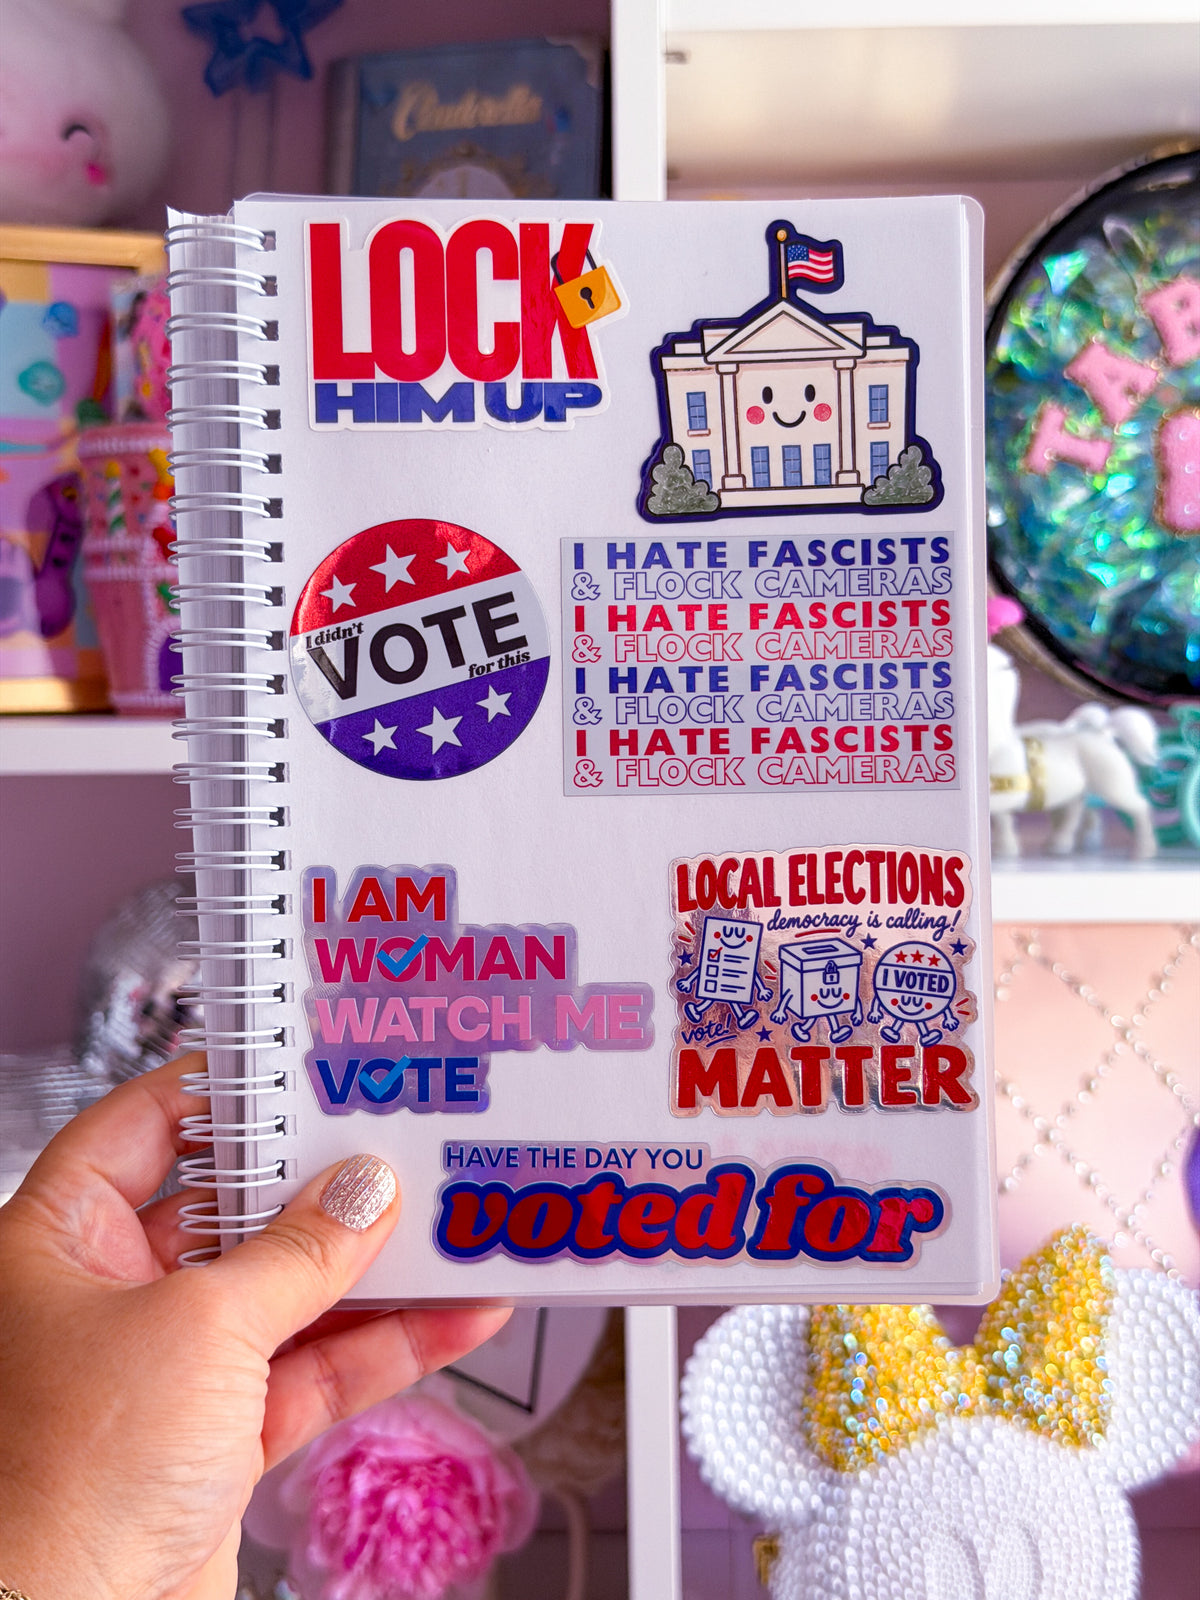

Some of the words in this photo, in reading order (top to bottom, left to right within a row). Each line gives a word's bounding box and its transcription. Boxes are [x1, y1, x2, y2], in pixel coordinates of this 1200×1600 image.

[310, 219, 599, 382] LOCK
[314, 382, 476, 424] HIM
[484, 382, 603, 423] UP
[574, 543, 584, 569] I
[607, 541, 727, 570] HATE
[748, 537, 949, 568] FASCISTS
[571, 572, 600, 600] &
[614, 570, 742, 600] FLOCK
[754, 566, 953, 598] CAMERAS
[575, 605, 585, 632] I
[608, 604, 728, 632] HATE
[749, 599, 950, 630] FASCISTS
[306, 635, 312, 649] I
[306, 591, 528, 700] VOTE
[572, 634, 601, 663] &
[615, 632, 743, 663] FLOCK
[755, 628, 953, 660] CAMERAS
[468, 663, 495, 678] for
[498, 651, 530, 669] this
[575, 667, 585, 694] I
[609, 665, 729, 694] HATE
[750, 661, 952, 692] FASCISTS
[572, 697, 602, 725] &
[616, 694, 744, 725] FLOCK
[756, 691, 954, 723] CAMERAS
[576, 729, 587, 757] I
[609, 727, 730, 756] HATE
[751, 724, 953, 755] FASCISTS
[573, 759, 604, 788] &
[617, 757, 745, 787] FLOCK
[757, 753, 956, 785] CAMERAS
[676, 857, 781, 913] LOCAL
[788, 850, 965, 908] ELECTIONS
[312, 878, 326, 923] I
[347, 876, 447, 923] AM
[767, 909, 862, 937] democracy
[867, 911, 882, 928] is
[886, 908, 962, 941] calling!
[314, 934, 566, 983] WOMAN
[882, 968, 889, 987] I
[894, 969, 950, 993] VOTED
[315, 995, 531, 1044] WATCH
[555, 994, 644, 1040] ME
[681, 1013, 732, 1044] vote!
[315, 1056, 479, 1105] VOTE
[677, 1045, 973, 1108] MATTER
[446, 1146, 519, 1168] HAVE
[527, 1147, 576, 1169] THE
[585, 1148, 638, 1169] DAY
[642, 1148, 703, 1170] YOU
[443, 1169, 750, 1253] voted
[753, 1172, 937, 1254] for
